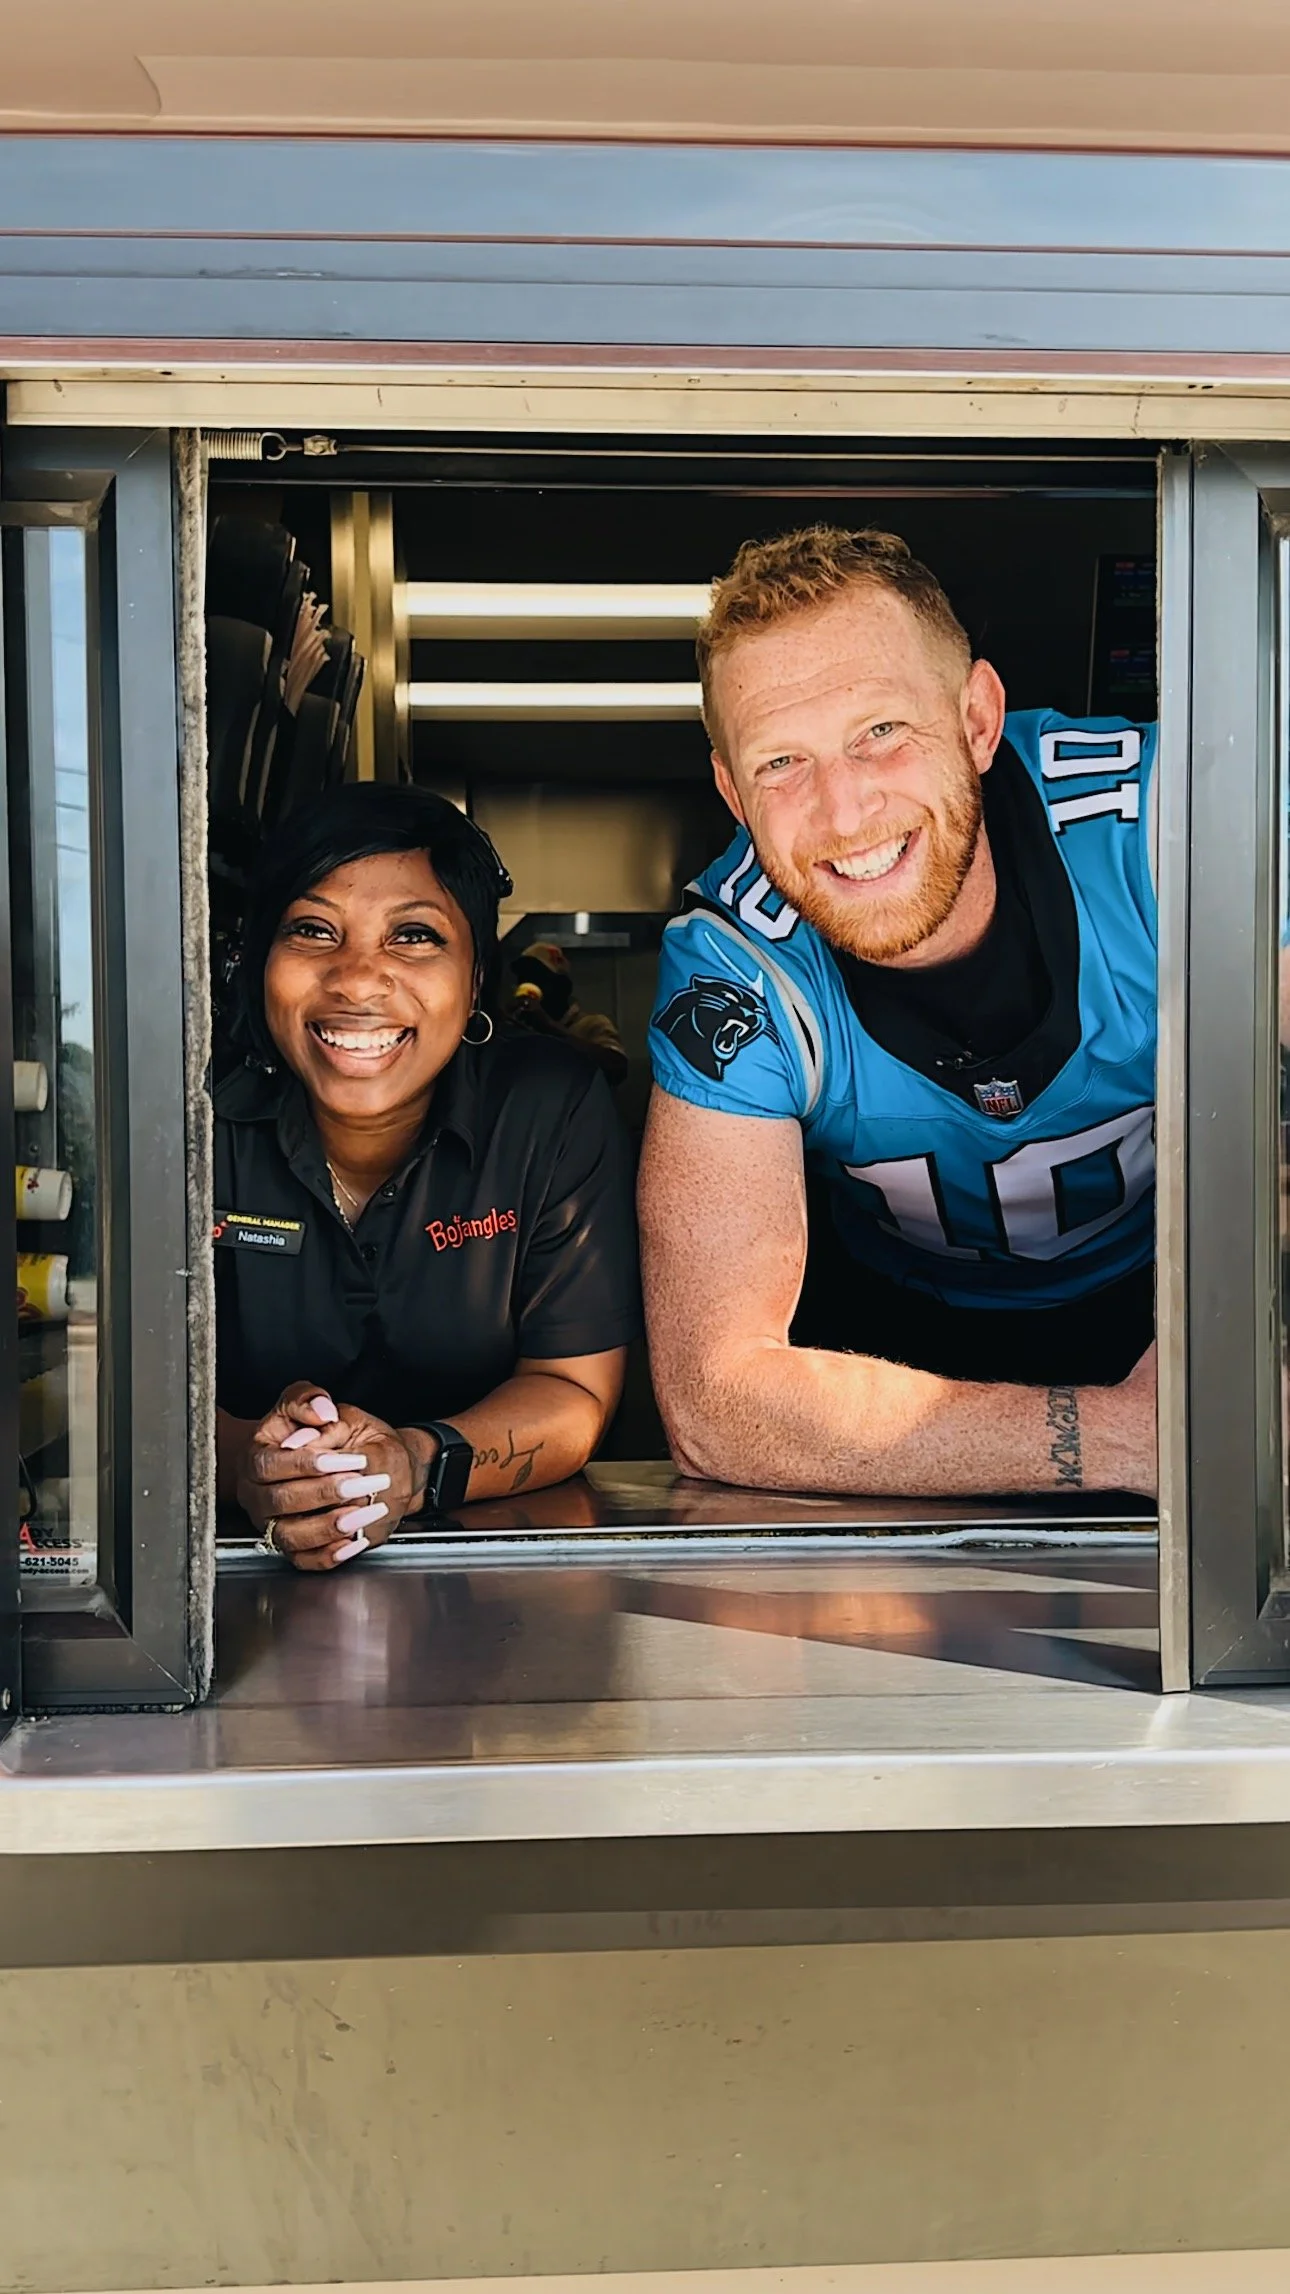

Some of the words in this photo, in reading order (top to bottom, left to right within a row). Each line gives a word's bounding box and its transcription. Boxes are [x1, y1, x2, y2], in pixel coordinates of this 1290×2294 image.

[1039, 729, 1142, 834] 10
[984, 1097, 1019, 1112] NFL
[842, 1104, 1156, 1262] 10
[226, 1214, 262, 1226] GENERAL
[262, 1219, 301, 1231] MANAGER
[425, 1207, 516, 1251] Bojangles
[238, 1230, 286, 1247] Natashia
[20, 1557, 79, 1567] -621-5045
